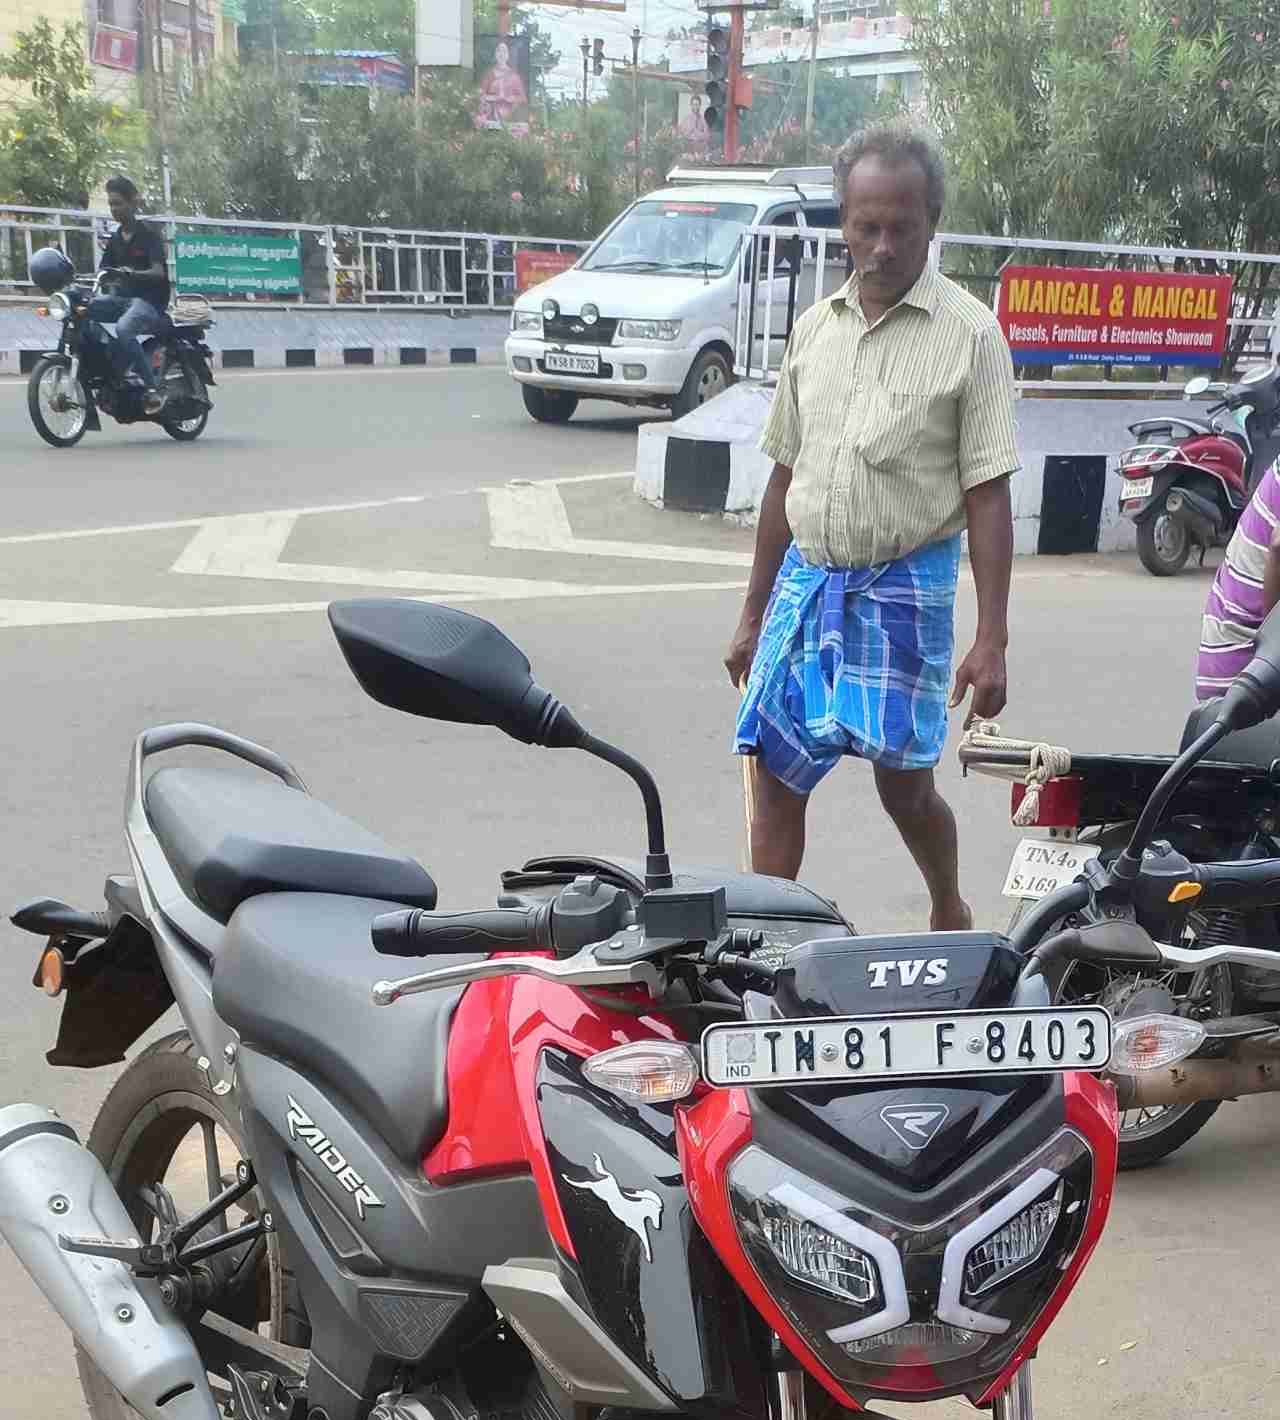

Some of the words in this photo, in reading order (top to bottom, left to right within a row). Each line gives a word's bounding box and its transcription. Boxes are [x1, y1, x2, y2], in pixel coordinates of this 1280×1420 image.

[1008, 278, 1101, 316] MANGAL
[1109, 284, 1125, 318] &
[1132, 285, 1219, 321] MANGAL
[1009, 324, 1049, 344] Vessels,
[1052, 325, 1098, 345] Furniture
[1100, 326, 1107, 343] &
[1111, 326, 1163, 345] Electronics
[1164, 329, 1213, 347] Showroom
[866, 958, 948, 989] TVS
[764, 1030, 815, 1074] TN
[842, 1026, 893, 1071] 81
[935, 1021, 956, 1066] F
[985, 1017, 1097, 1064] 8403
[725, 1065, 752, 1079] IND
[287, 1094, 385, 1221] RAIDER
